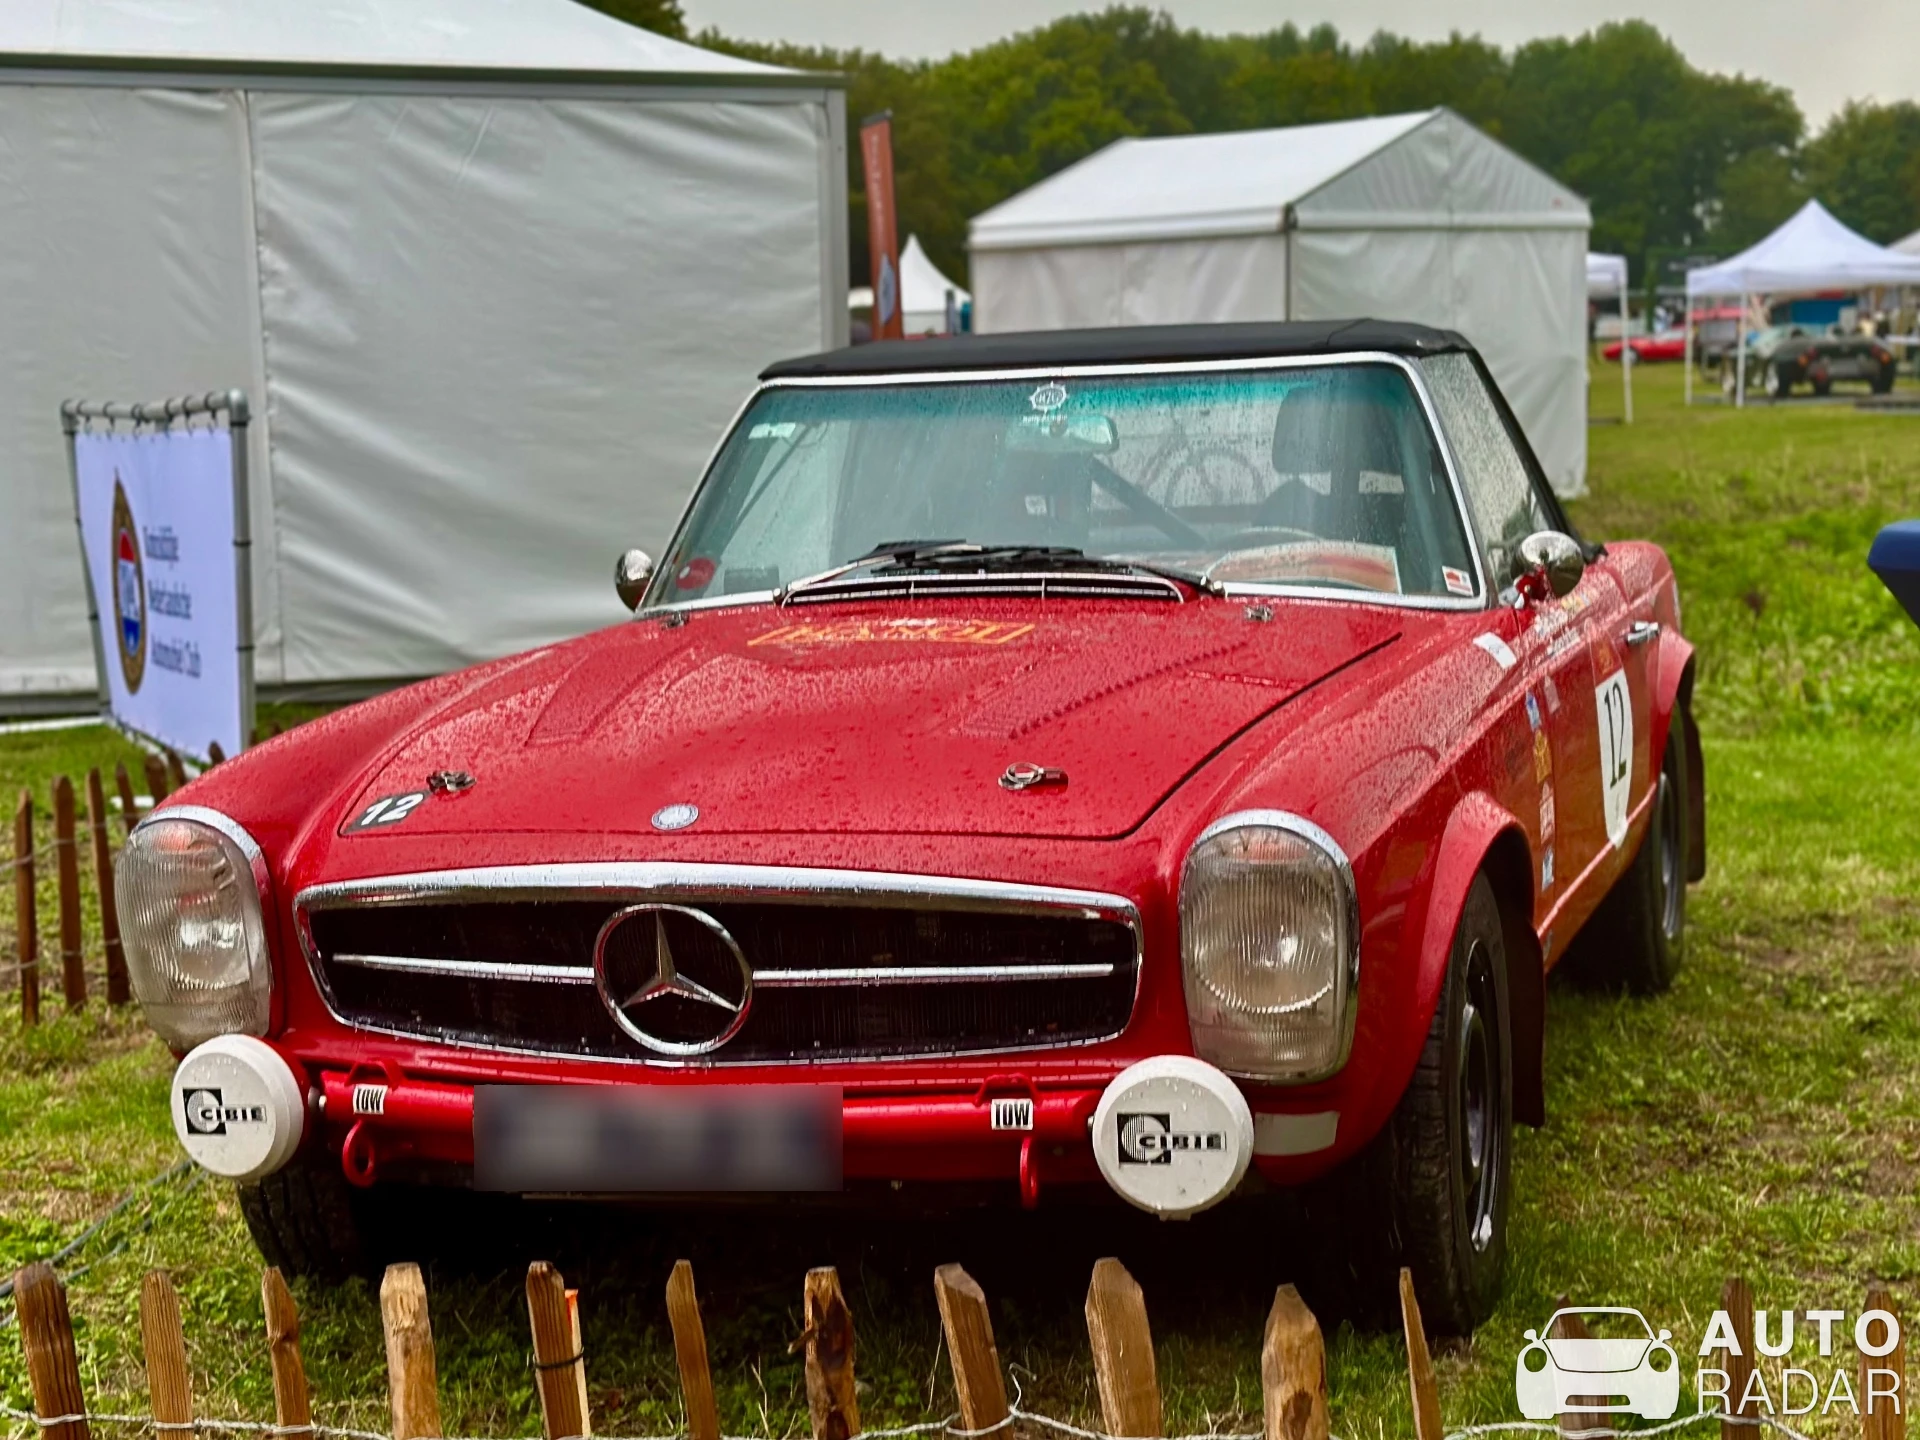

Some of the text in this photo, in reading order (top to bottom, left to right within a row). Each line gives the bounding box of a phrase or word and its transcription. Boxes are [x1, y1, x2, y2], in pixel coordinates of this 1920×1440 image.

[1604, 681, 1627, 790] 12
[361, 793, 424, 826] 12
[200, 1107, 264, 1121] CIBIE
[994, 1101, 1031, 1128] TOW
[1139, 1134, 1222, 1150] CIBIE
